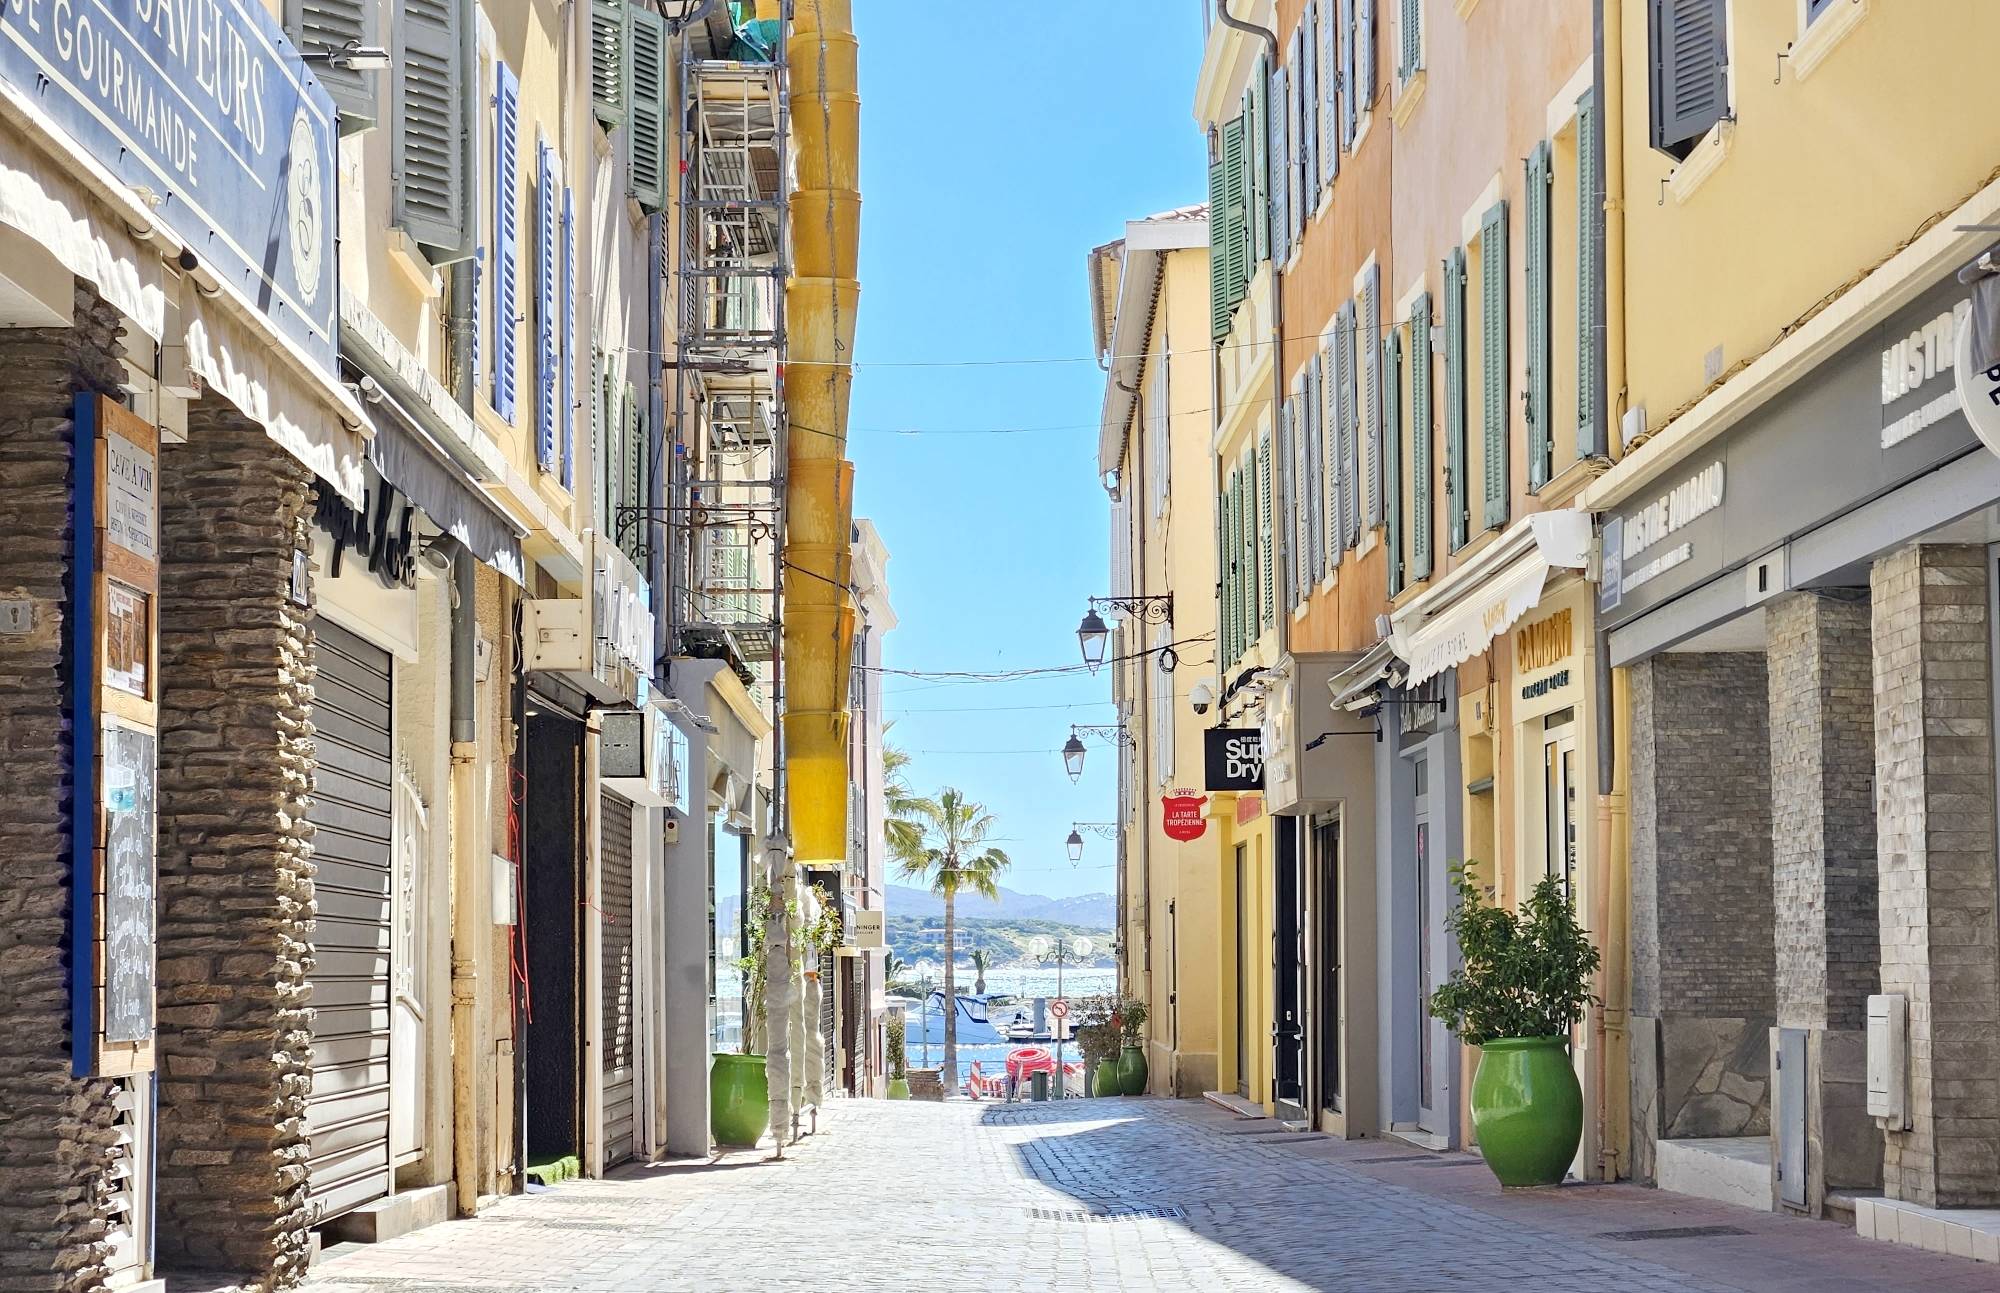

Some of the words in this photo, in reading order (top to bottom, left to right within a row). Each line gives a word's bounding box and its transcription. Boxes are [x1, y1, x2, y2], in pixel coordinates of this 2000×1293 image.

[54, 0, 198, 187] GOURMANDE
[136, 0, 265, 155] AVEURS
[111, 449, 130, 481] CAVE
[138, 465, 152, 493] VIN
[1517, 609, 1571, 673] BAMBINI
[1227, 759, 1262, 783] Dry
[1167, 818, 1204, 826] TROPÉZIENNE
[1171, 811, 1180, 819] LA
